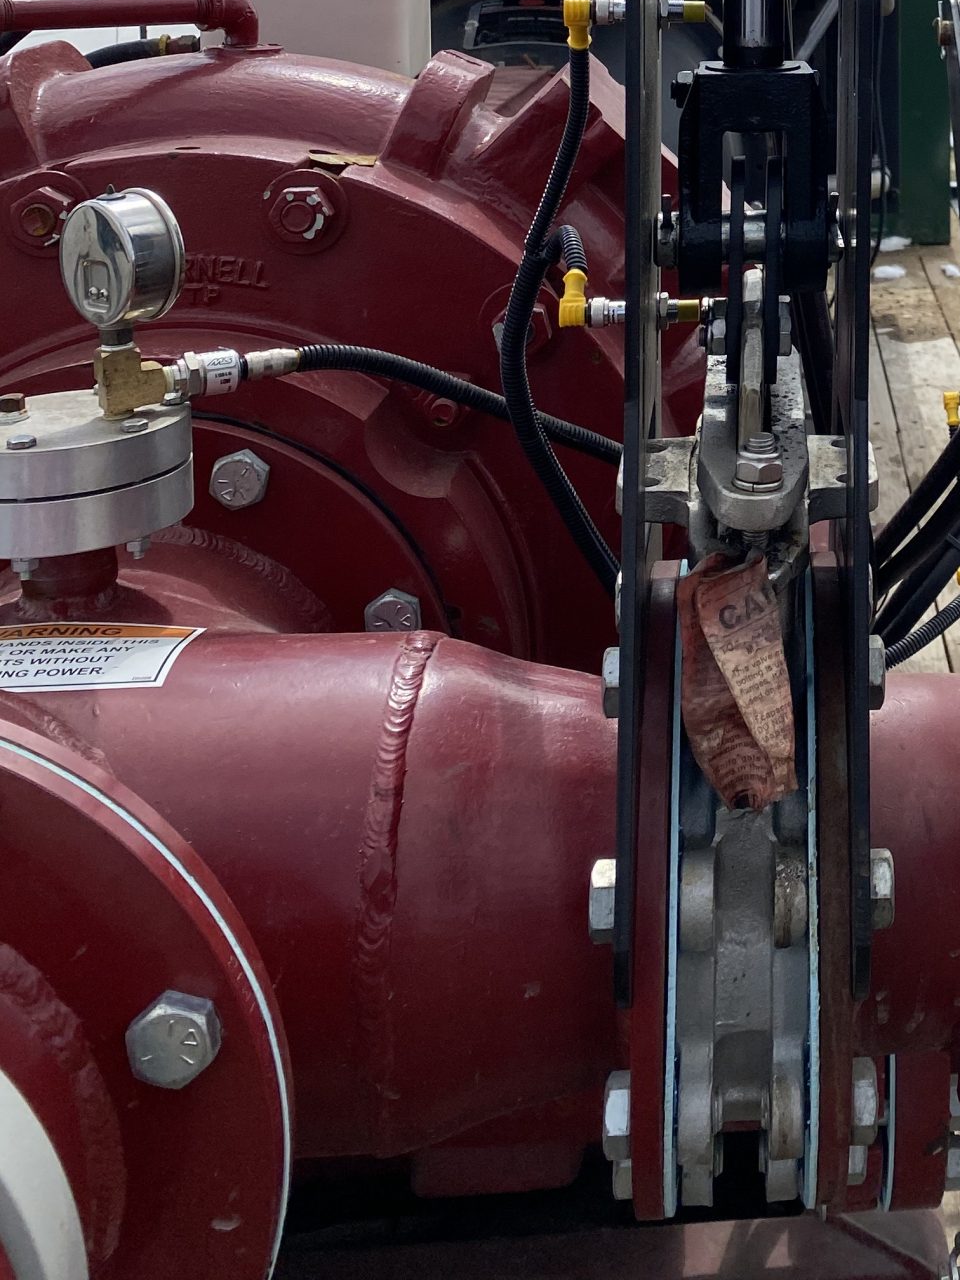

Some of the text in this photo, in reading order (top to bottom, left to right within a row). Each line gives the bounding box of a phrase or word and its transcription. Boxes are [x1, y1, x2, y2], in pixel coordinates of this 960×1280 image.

[0, 627, 122, 638] ARNING
[30, 655, 115, 665] WITHOUT
[33, 667, 105, 677] POWER.
